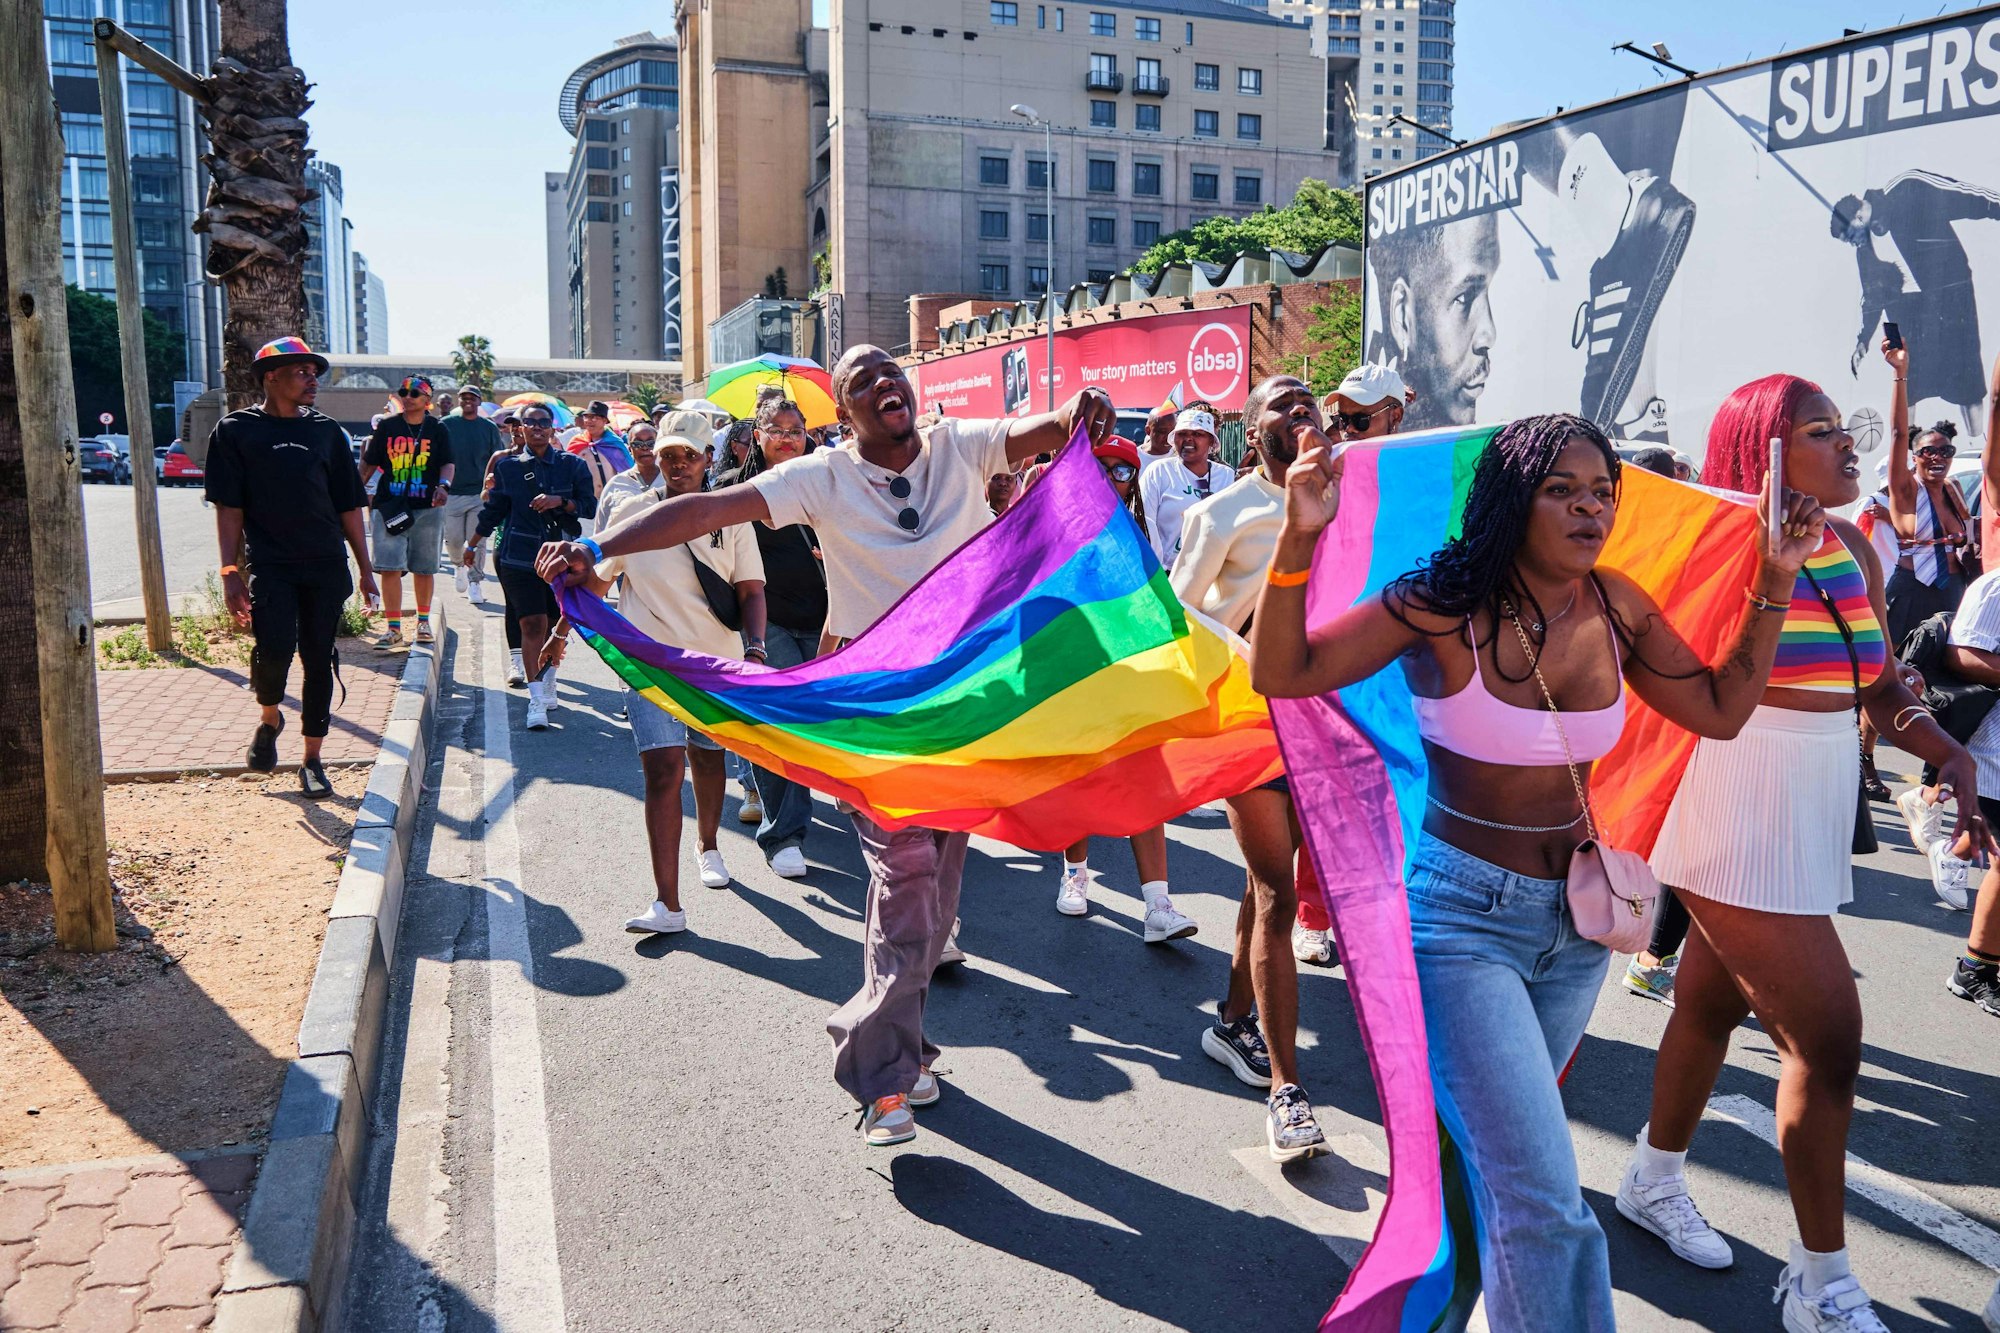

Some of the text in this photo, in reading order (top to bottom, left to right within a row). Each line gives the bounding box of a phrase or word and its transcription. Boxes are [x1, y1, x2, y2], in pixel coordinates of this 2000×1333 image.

[1775, 17, 2000, 140] SUPERS
[1369, 140, 1519, 239] SUPERSTAR
[1193, 347, 1237, 372] absa
[973, 372, 992, 387] Banking
[1080, 359, 1177, 383] Your story matters
[387, 436, 431, 456] LOVE
[388, 453, 428, 471] WHO
[392, 465, 422, 485] YOU
